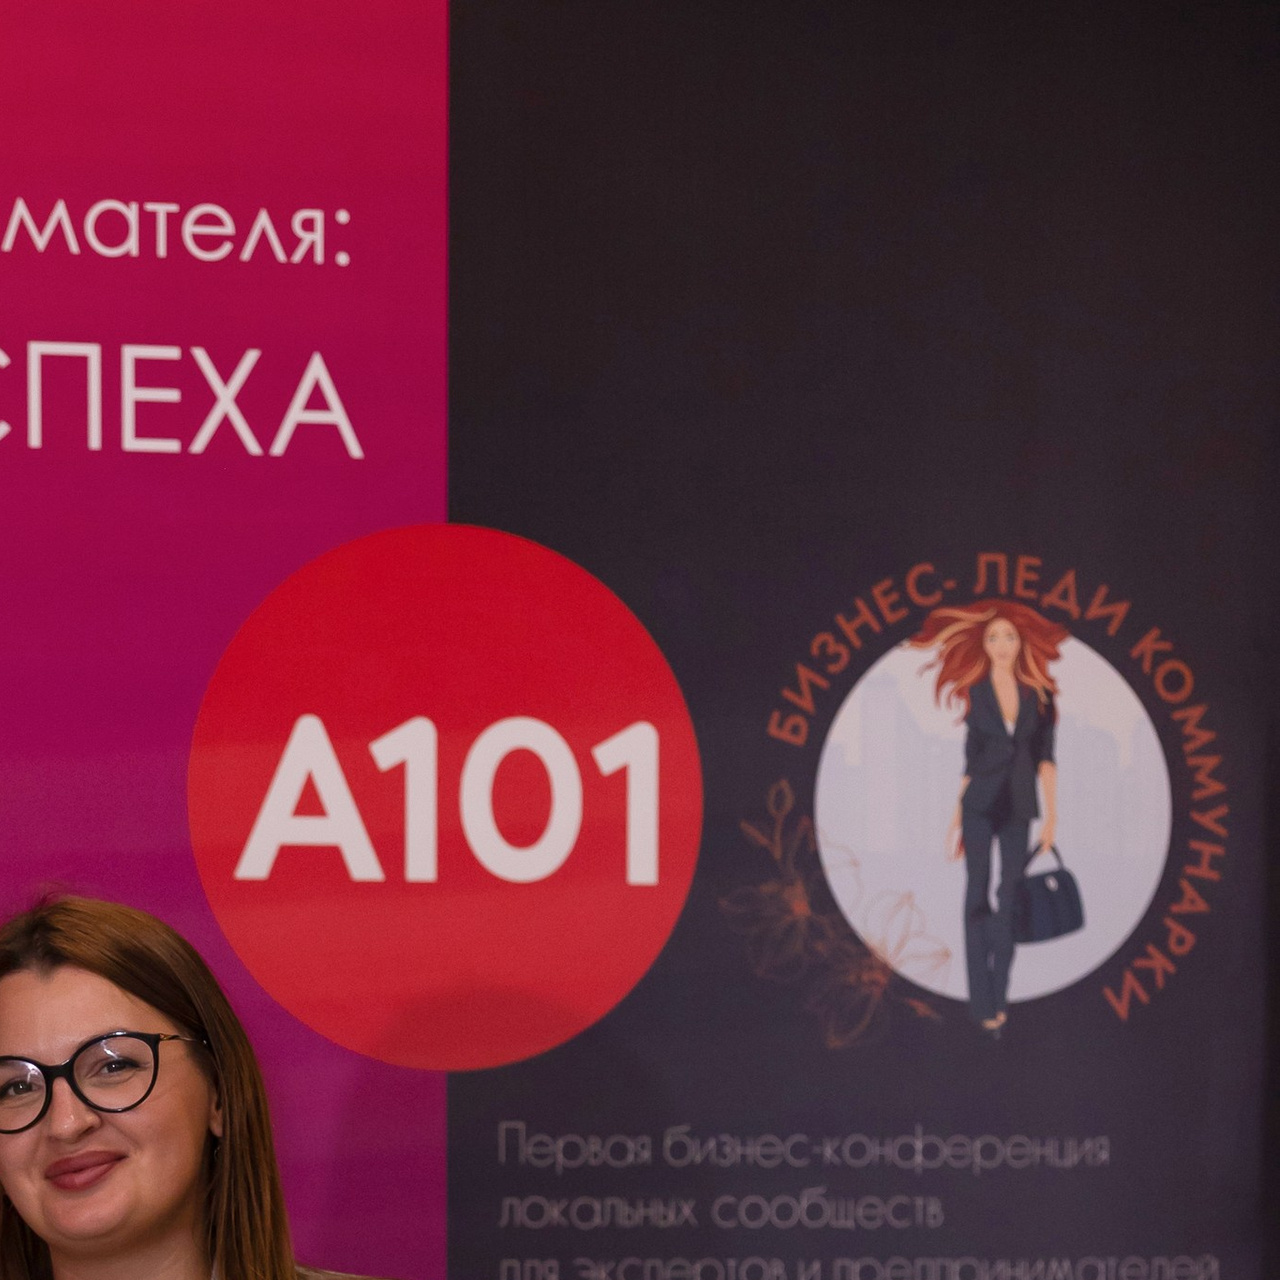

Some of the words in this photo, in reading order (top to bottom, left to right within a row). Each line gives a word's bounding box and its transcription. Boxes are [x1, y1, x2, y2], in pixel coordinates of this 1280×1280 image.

[232, 712, 660, 887] A101
[1103, 626, 1230, 1021] КОММУНАРКИ
[496, 1120, 652, 1176] Первая
[662, 1122, 1111, 1176] бизнес-конференция
[499, 1195, 699, 1231] локальных
[710, 1185, 945, 1231] сообществ
